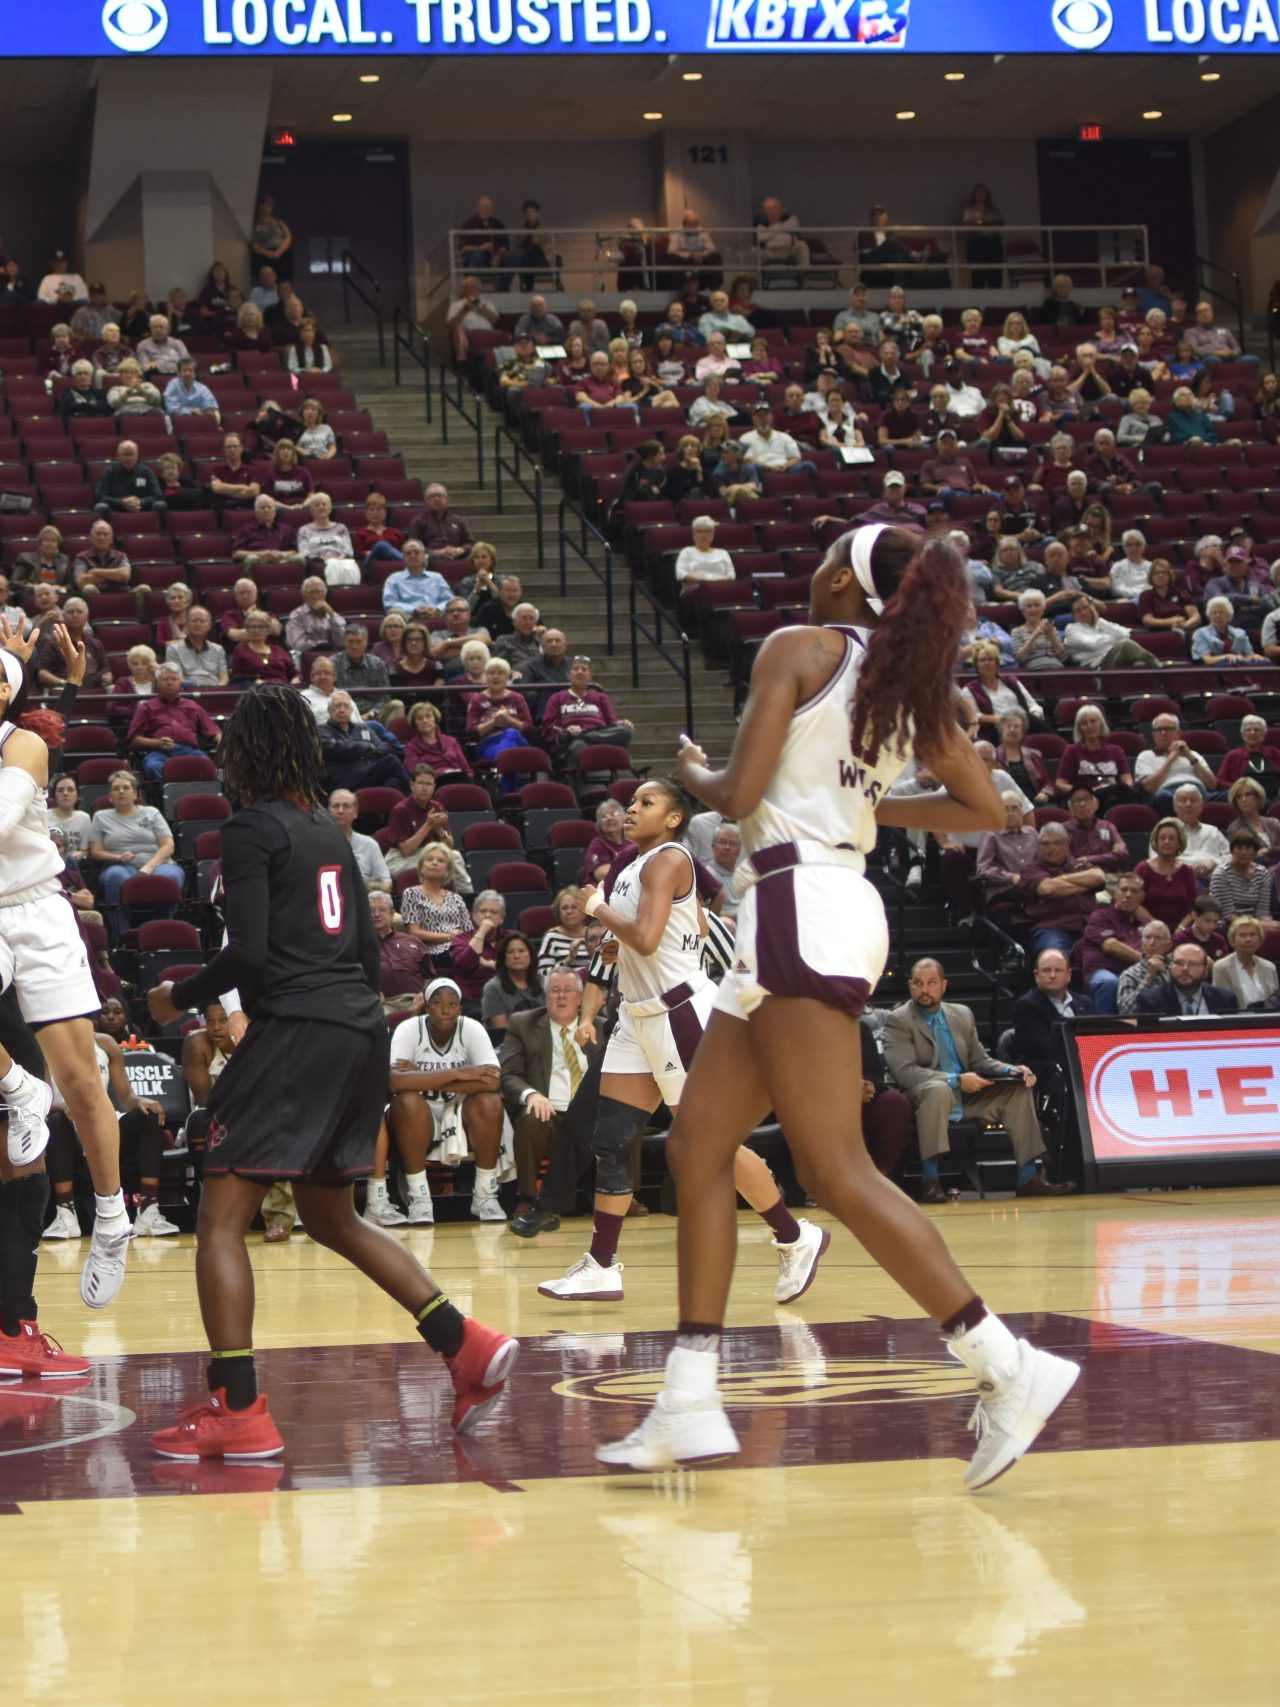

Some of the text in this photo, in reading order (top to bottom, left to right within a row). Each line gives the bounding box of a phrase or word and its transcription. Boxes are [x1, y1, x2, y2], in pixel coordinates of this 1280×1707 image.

[202, 0, 667, 45] LOCAL. TRUSTED.
[717, 0, 854, 41] KBTX
[688, 145, 728, 163] 121
[319, 865, 343, 934] 0
